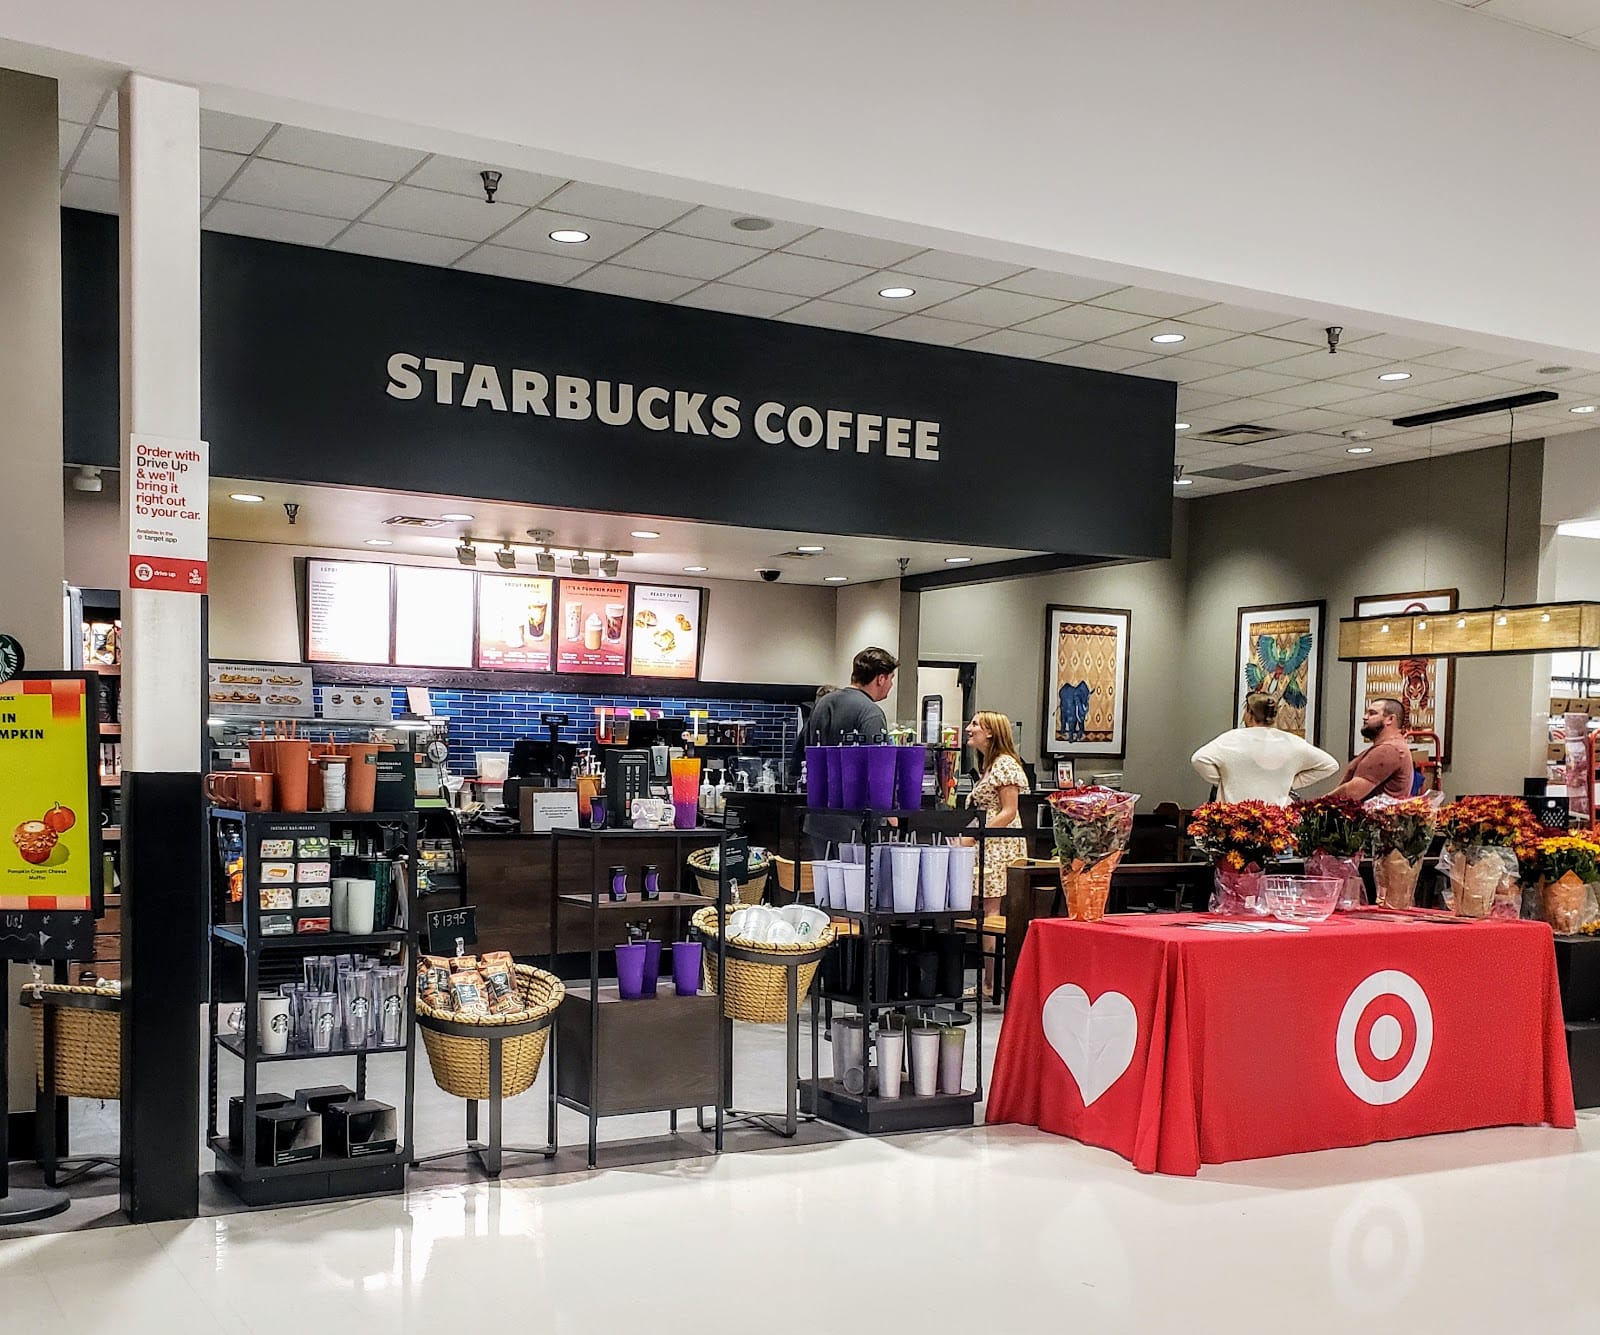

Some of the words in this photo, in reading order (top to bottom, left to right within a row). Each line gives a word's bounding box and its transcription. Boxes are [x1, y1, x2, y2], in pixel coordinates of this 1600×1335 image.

[386, 352, 741, 440] STARBUCKS
[754, 401, 941, 461] COFFEE
[136, 444, 172, 459] Order
[174, 449, 200, 462] with
[136, 456, 169, 469] Drive
[171, 460, 188, 474] Up
[136, 468, 146, 479] &
[148, 471, 175, 482] we'll
[136, 479, 168, 495] bring
[170, 482, 178, 494] it
[136, 492, 164, 506] right
[166, 497, 186, 507] out
[136, 504, 149, 515] to
[151, 507, 178, 518] your
[180, 510, 201, 520] car.
[2, 713, 16, 723] IN
[6, 914, 24, 929] Us!
